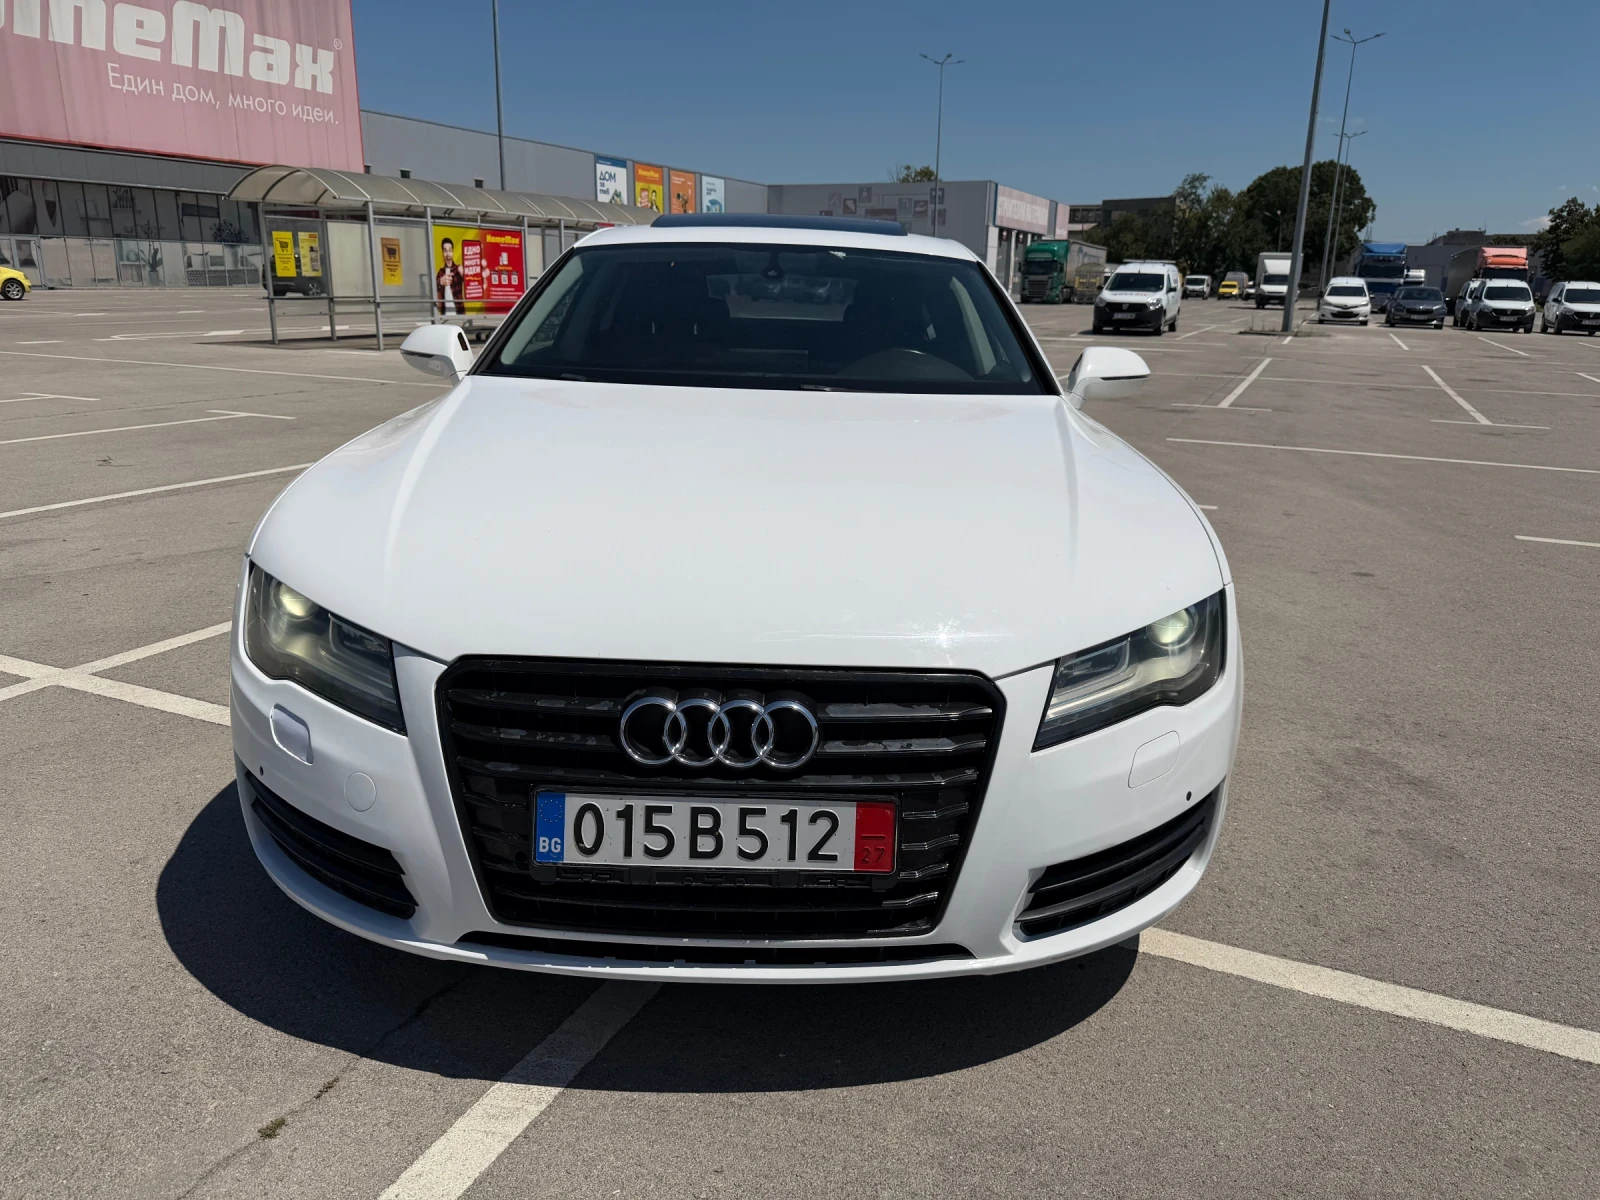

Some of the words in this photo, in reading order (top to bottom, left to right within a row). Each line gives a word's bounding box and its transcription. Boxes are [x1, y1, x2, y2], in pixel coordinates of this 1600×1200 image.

[107, 62, 165, 96] Един
[172, 82, 220, 110] дом,
[228, 92, 287, 116] много
[292, 103, 340, 125] идеи.
[599, 170, 616, 183] ДОМ
[573, 801, 840, 862] 015B512
[539, 836, 561, 853] BG
[861, 845, 886, 864] 27
